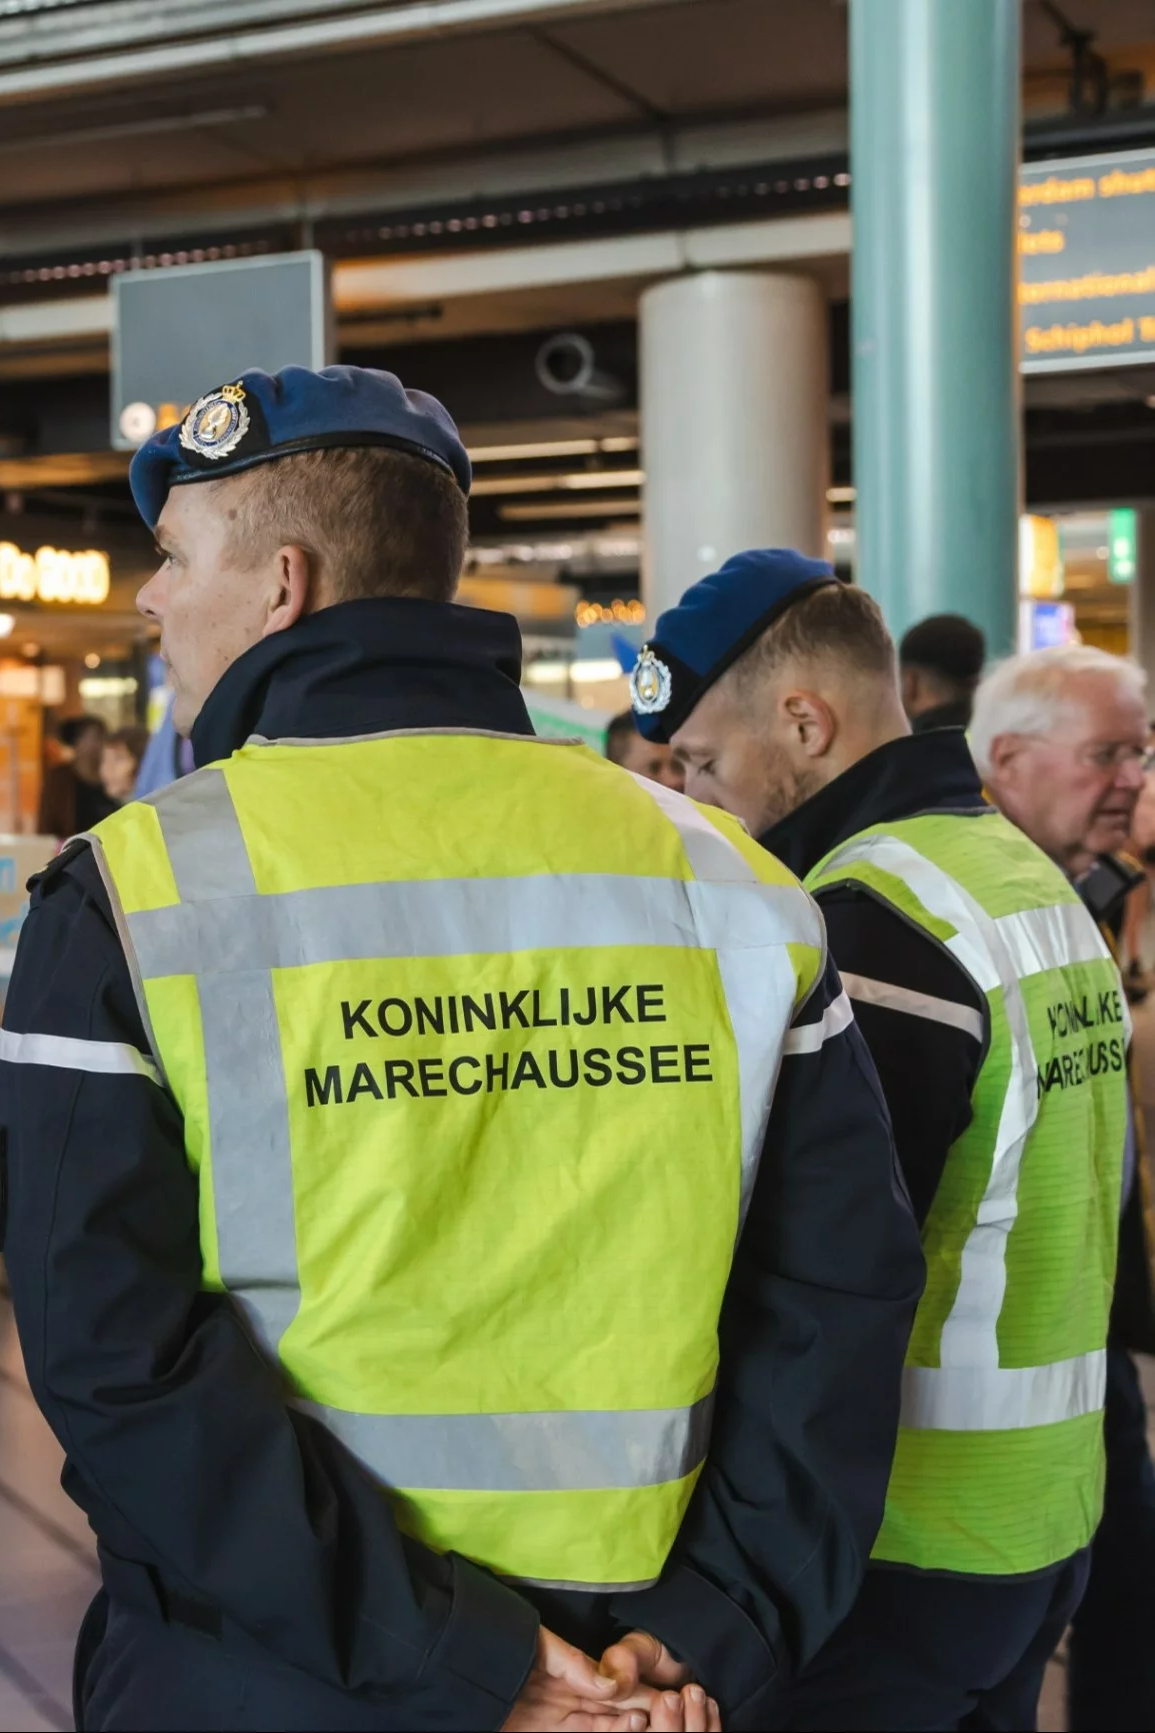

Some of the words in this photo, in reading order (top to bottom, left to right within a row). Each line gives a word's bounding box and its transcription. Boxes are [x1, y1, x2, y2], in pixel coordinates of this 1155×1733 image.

[1025, 317, 1134, 353] Schiphol
[340, 984, 667, 1040] KONINKLIJKE
[304, 1044, 714, 1108] MARECHAUSSEE
